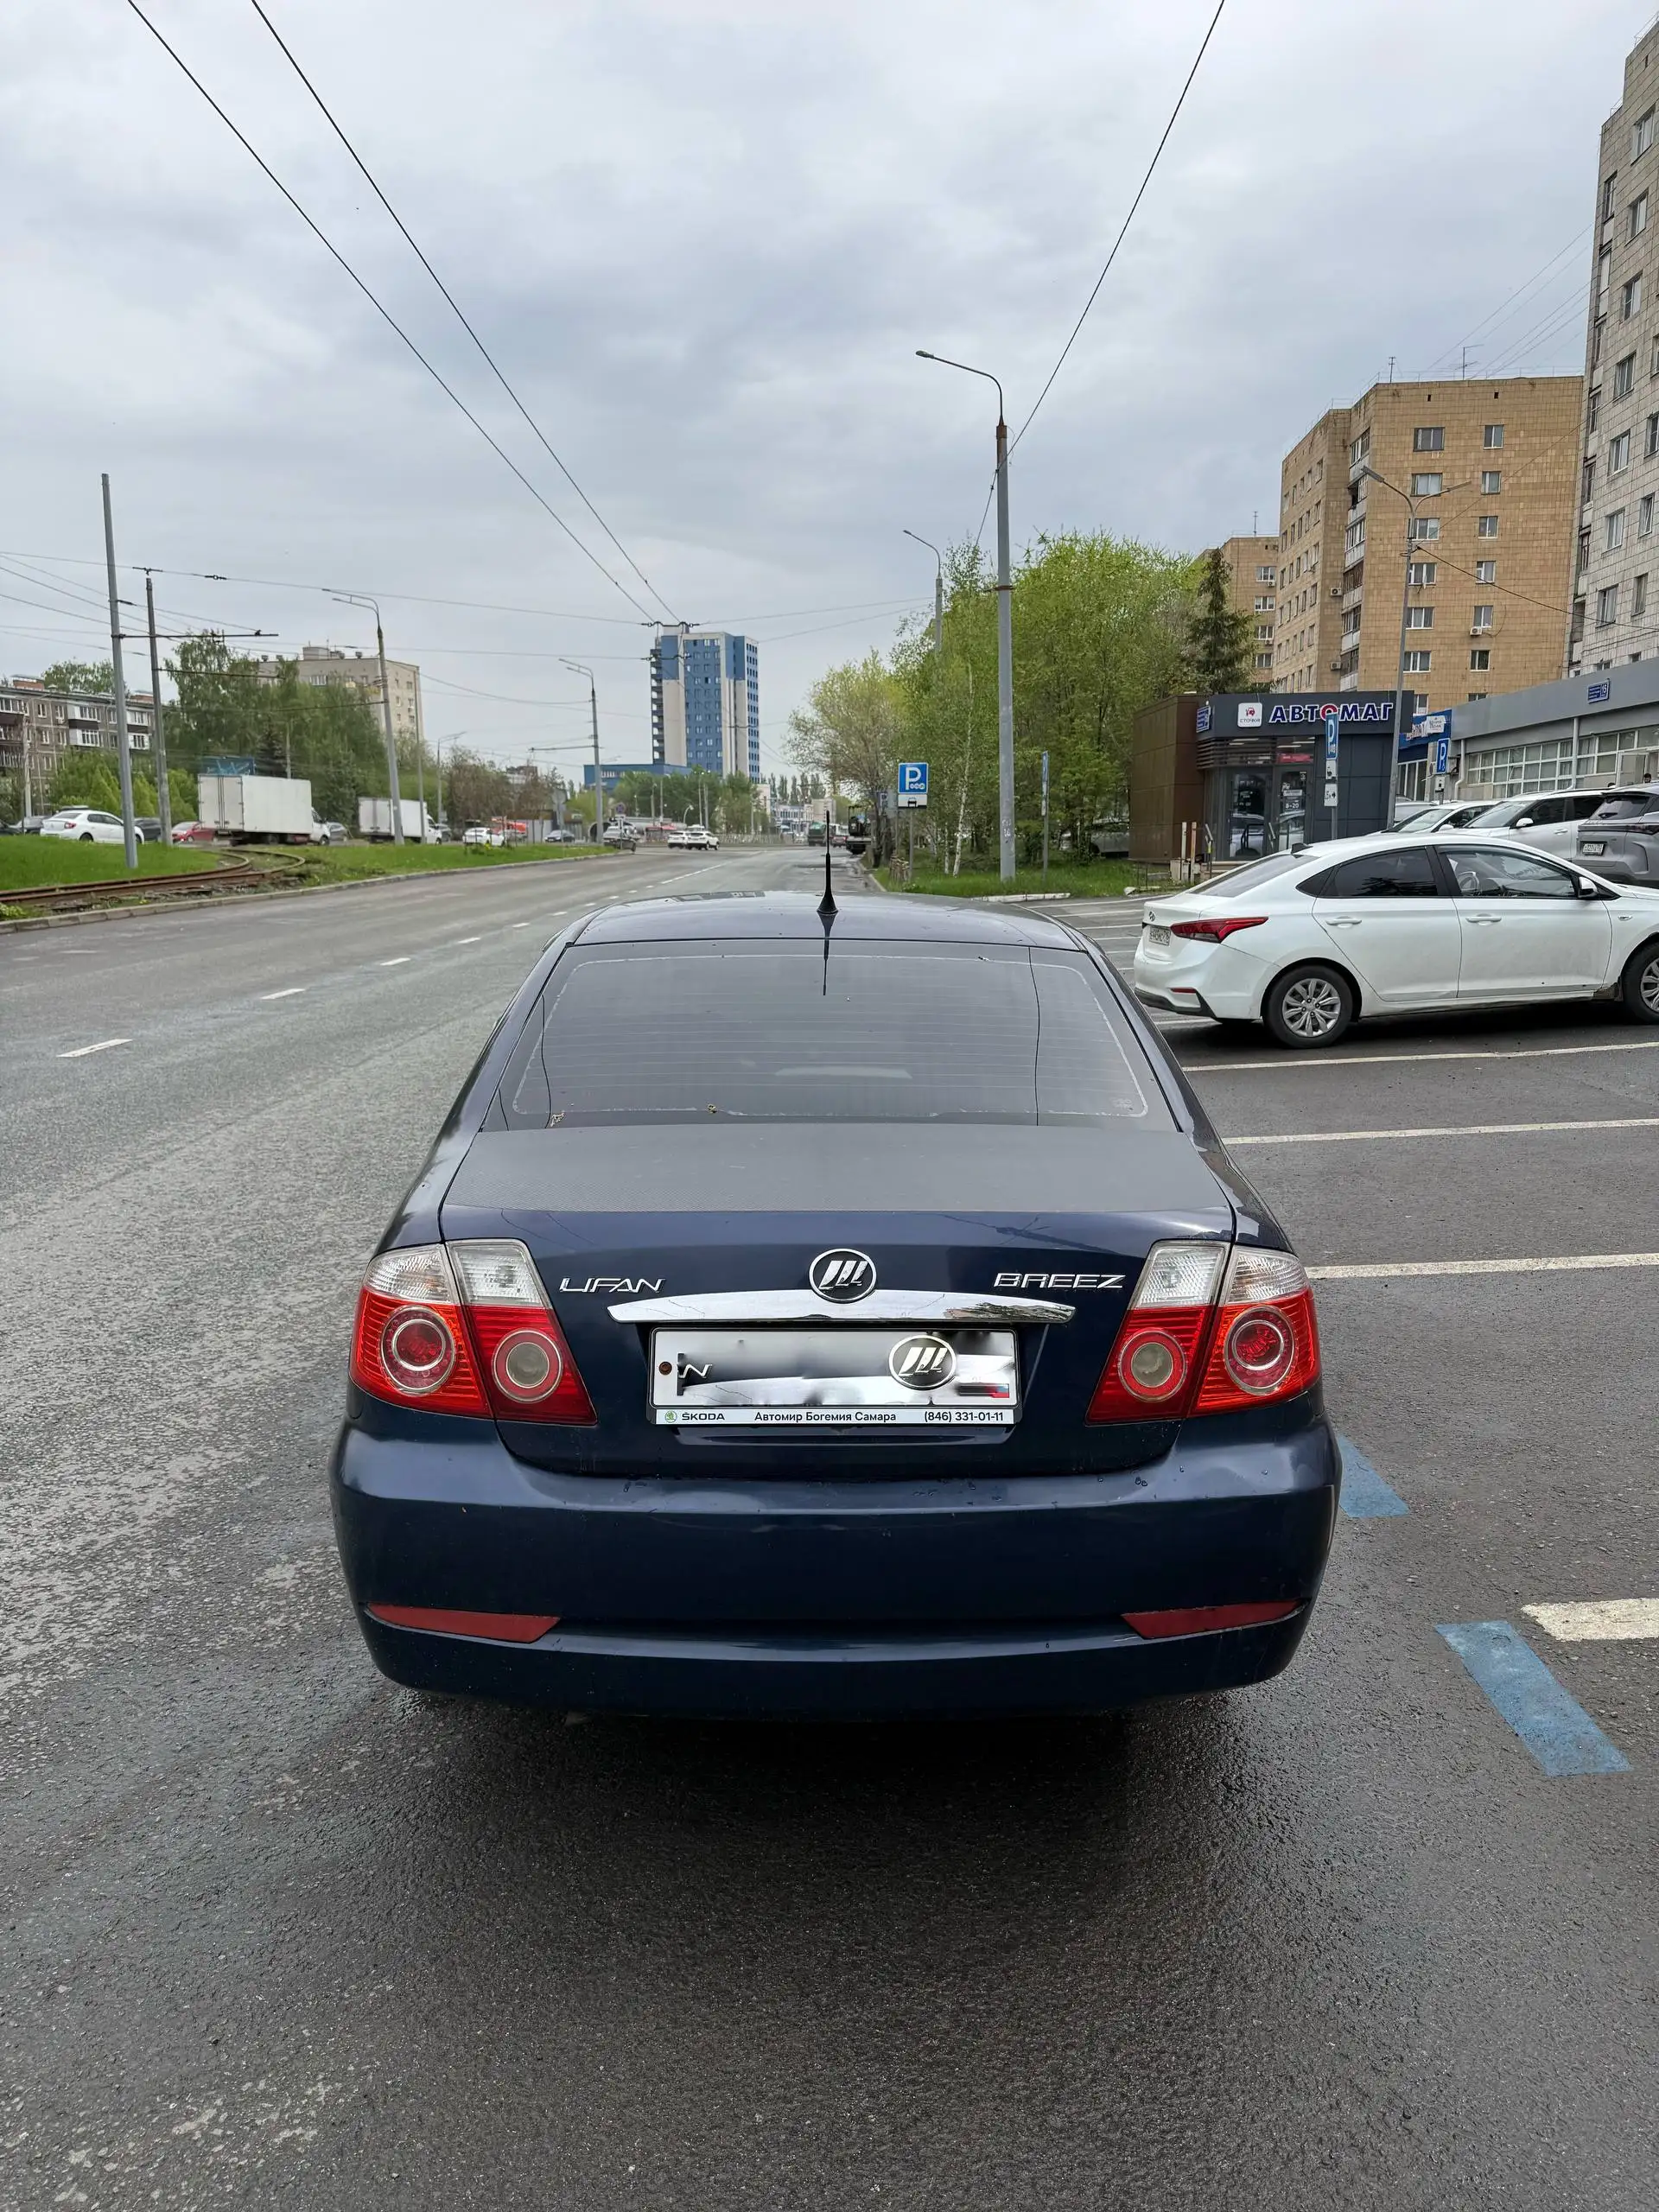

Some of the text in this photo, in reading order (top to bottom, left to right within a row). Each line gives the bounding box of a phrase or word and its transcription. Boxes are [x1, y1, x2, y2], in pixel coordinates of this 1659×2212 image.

[1268, 702, 1393, 723] АВТОМАГ
[906, 767, 922, 791] P
[559, 1277, 665, 1293] LIFAN
[994, 1273, 1126, 1288] BREEZ
[682, 1411, 725, 1421] ŠKODA
[754, 1411, 1004, 1422] Автомир Богемия Самара (846) 331-01-11
